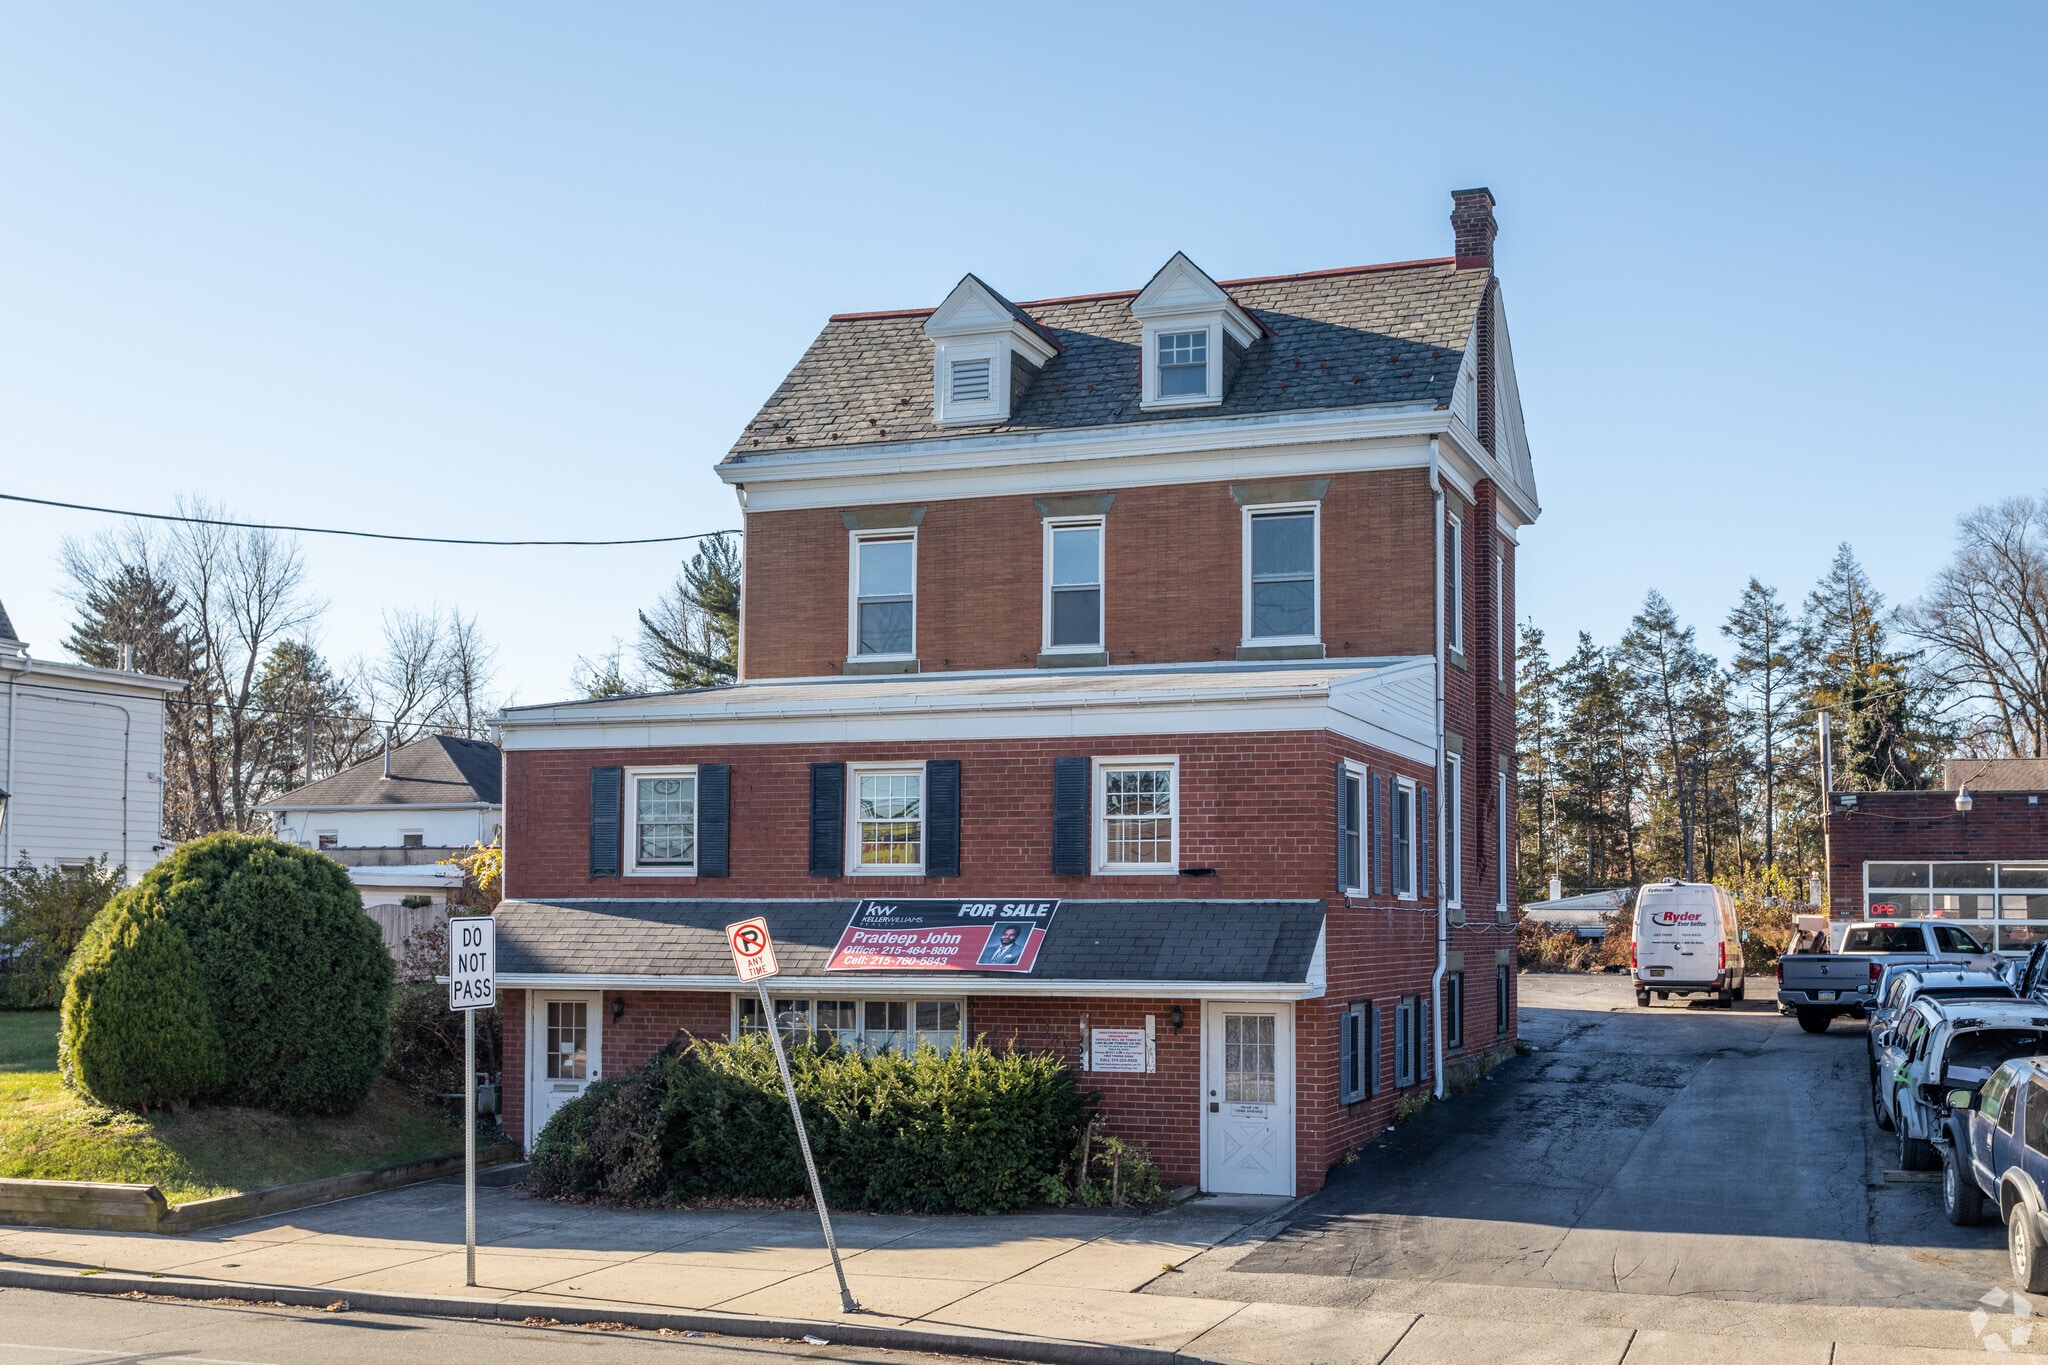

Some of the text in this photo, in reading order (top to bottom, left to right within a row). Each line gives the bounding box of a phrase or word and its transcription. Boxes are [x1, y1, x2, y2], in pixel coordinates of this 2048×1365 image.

[865, 901, 898, 916] kw
[958, 903, 1050, 917] FOR SALE
[1871, 903, 1902, 915] OPEN
[1663, 911, 1702, 923] Ryder
[463, 927, 482, 947] DO
[851, 931, 962, 946] Pradeep John
[844, 945, 959, 955] Office: 215-464-8800
[459, 952, 487, 973] NOT
[748, 956, 763, 967] ANY
[844, 956, 948, 965] Cell: 215-760-5843
[748, 964, 768, 976] TIME
[454, 978, 491, 1000] PASS
